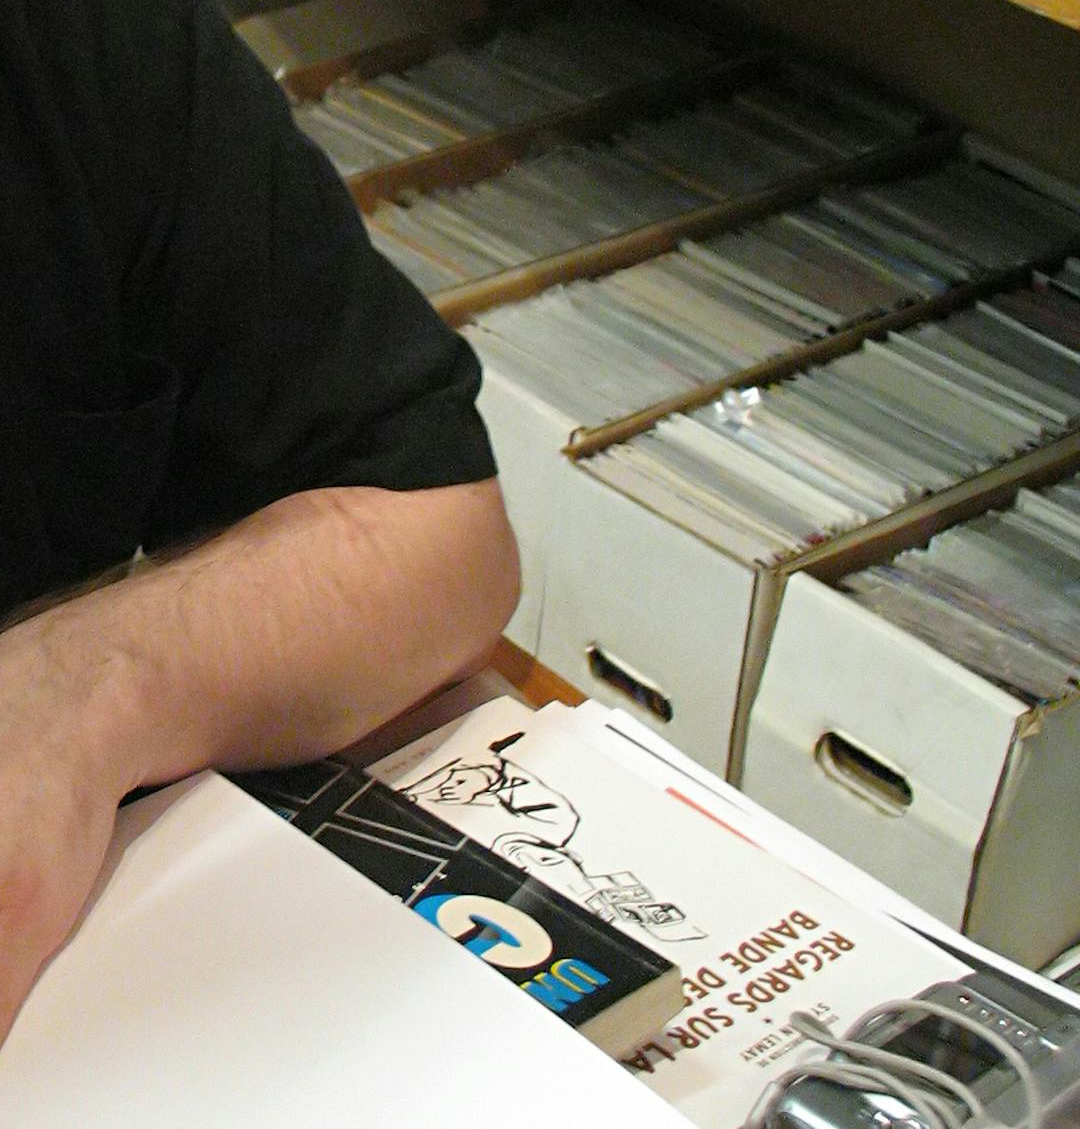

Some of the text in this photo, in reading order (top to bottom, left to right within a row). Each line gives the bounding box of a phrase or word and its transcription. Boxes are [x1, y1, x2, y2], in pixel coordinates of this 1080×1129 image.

[718, 909, 820, 975] BANDE
[618, 930, 856, 1075] REGARDS SUR LA
[739, 1033, 782, 1063] LEMAY
